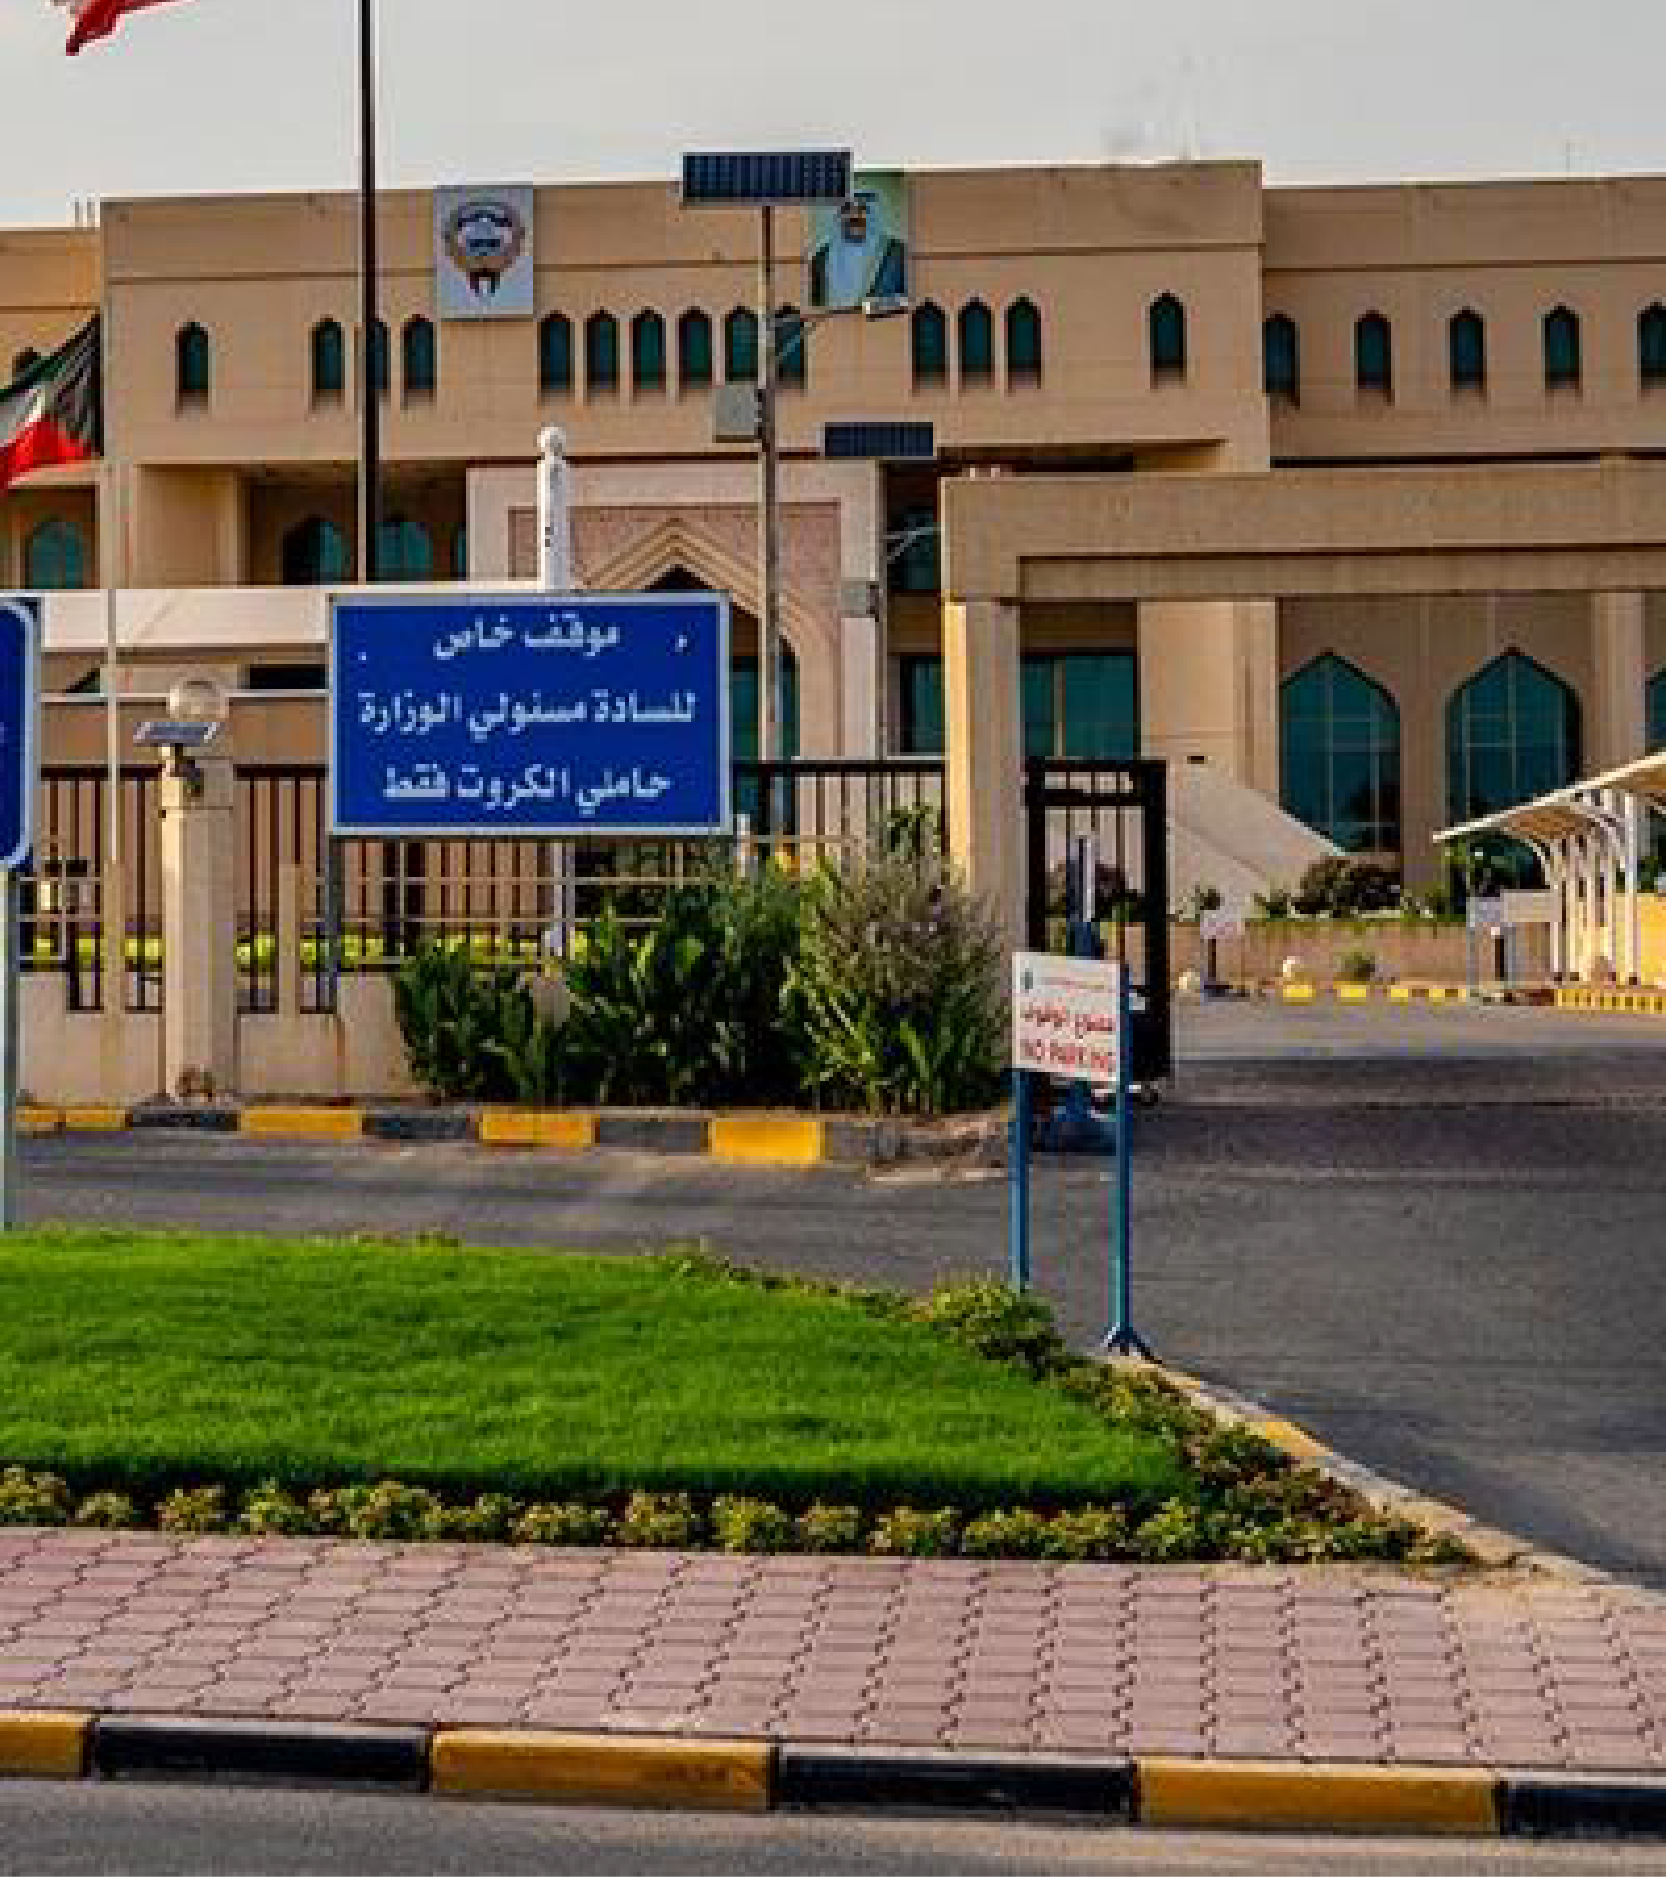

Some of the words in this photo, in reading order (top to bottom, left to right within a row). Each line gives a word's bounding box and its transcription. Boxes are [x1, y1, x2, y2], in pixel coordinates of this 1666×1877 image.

[433, 614, 515, 660] خاص
[524, 609, 621, 659] موقف
[357, 688, 463, 735] الوزارة
[594, 688, 697, 723] للسادة
[382, 763, 452, 800] فقط
[457, 763, 571, 811] الكروت
[575, 768, 671, 818] حاملي
